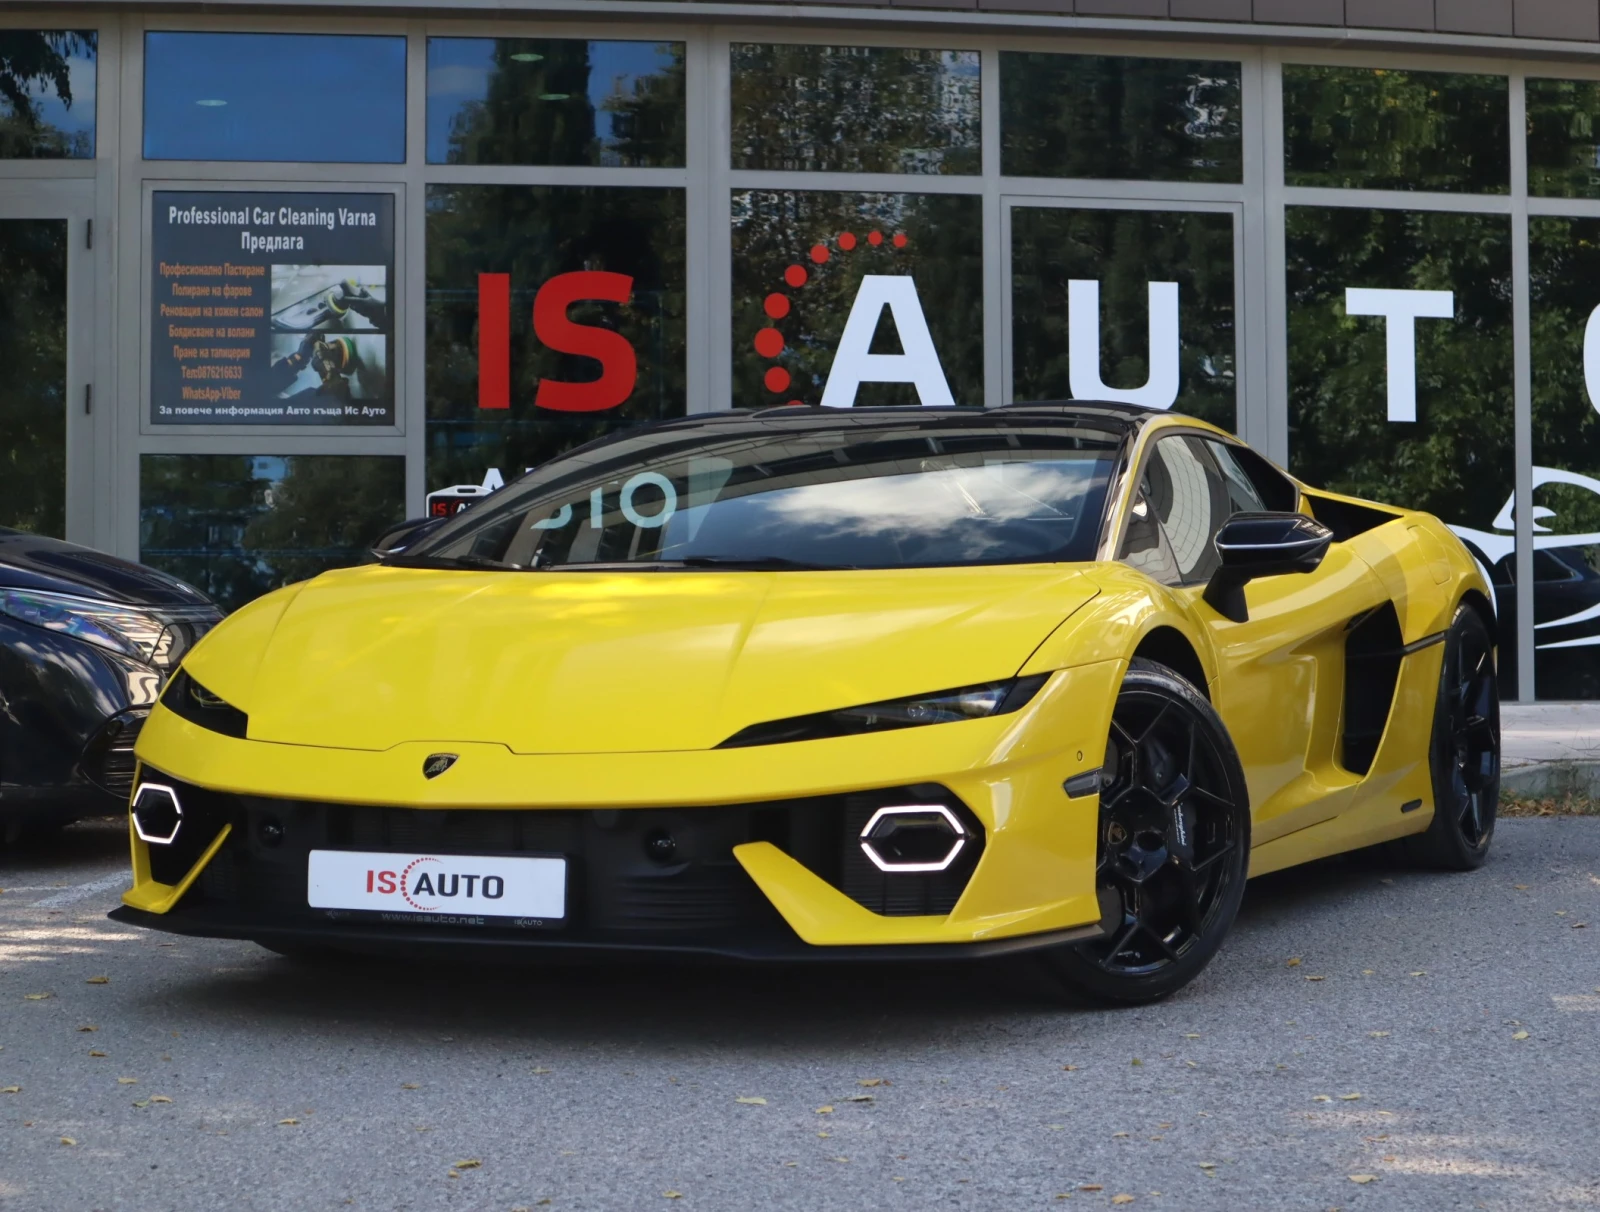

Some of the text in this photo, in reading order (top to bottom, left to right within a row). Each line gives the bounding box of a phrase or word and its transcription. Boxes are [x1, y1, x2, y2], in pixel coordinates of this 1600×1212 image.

[169, 206, 376, 230] Professional Car Cleaning Varna
[241, 231, 304, 253] Предлага
[160, 262, 222, 278] Професионално
[172, 282, 253, 299] Полиране на фарове
[203, 307, 213, 317] на
[214, 307, 239, 317] кожен
[240, 307, 264, 317] салон
[216, 328, 226, 338] на
[173, 345, 198, 361] Пране
[199, 348, 209, 358] на
[478, 270, 1600, 422] IS AUT
[159, 405, 386, 418] За повече информация Авто къща Ис Ауто
[432, 502, 447, 516] IS
[366, 870, 504, 899] IS AUTO
[381, 912, 485, 925] www.isauto.net
